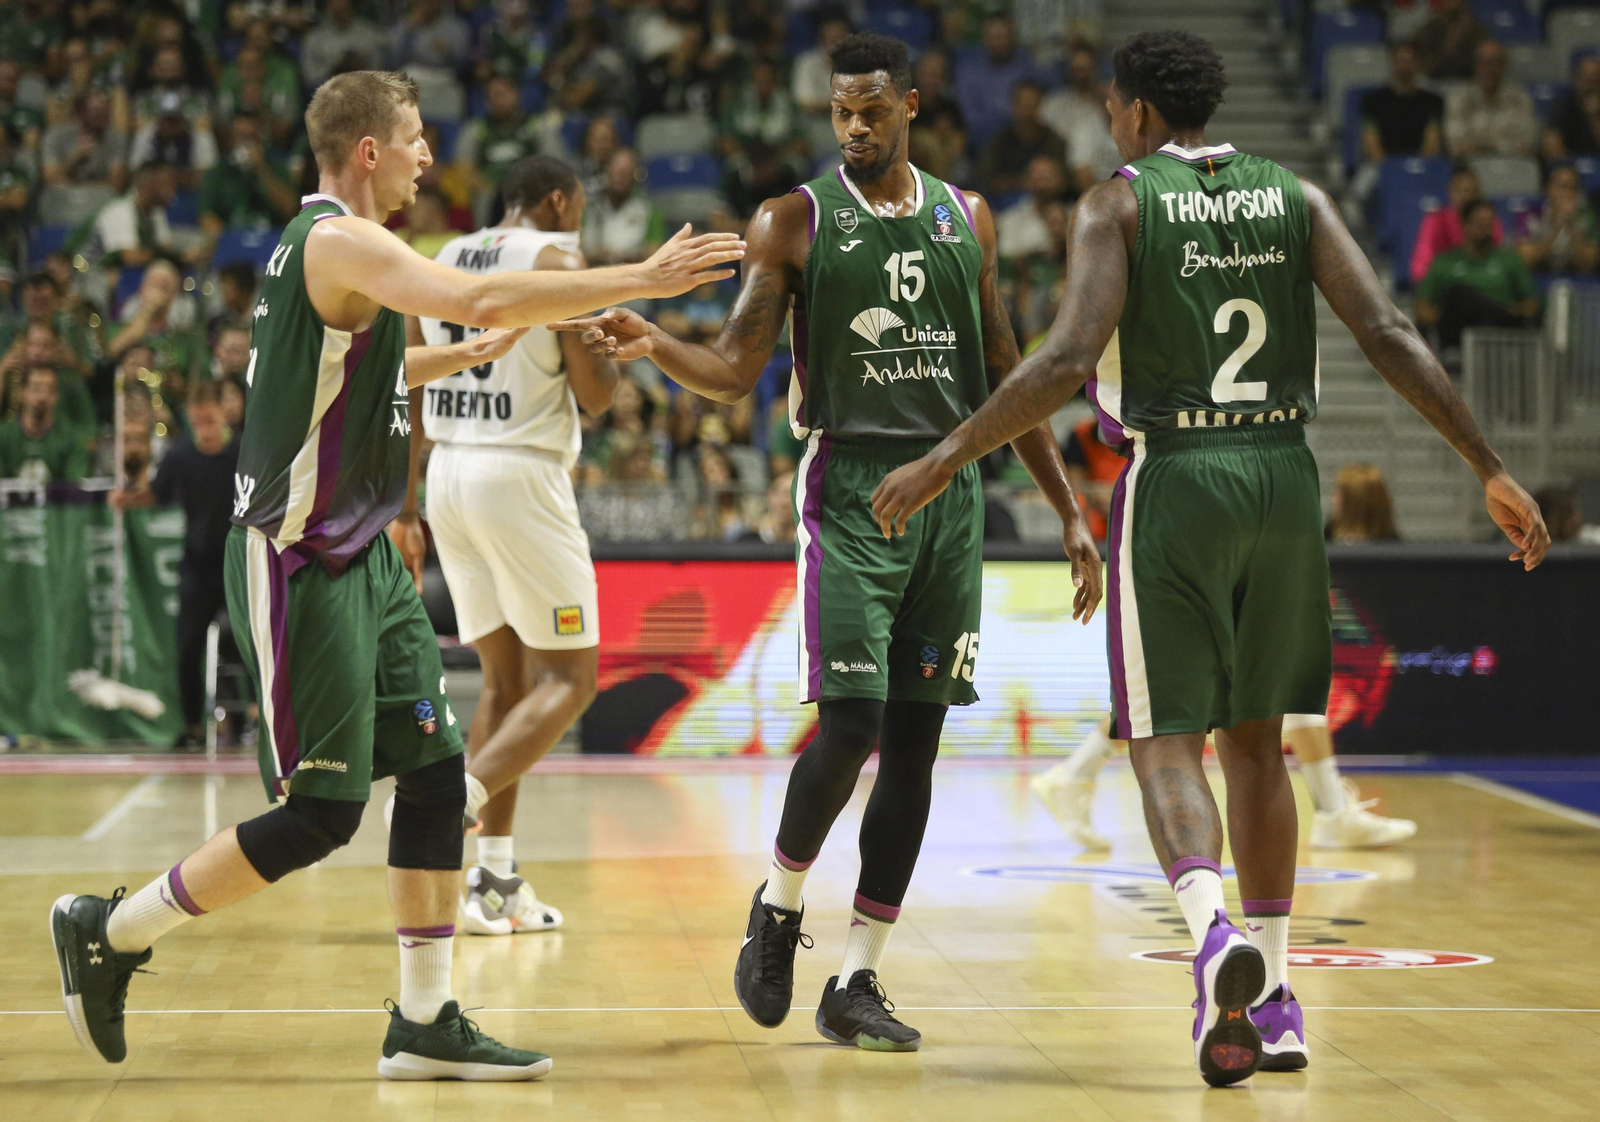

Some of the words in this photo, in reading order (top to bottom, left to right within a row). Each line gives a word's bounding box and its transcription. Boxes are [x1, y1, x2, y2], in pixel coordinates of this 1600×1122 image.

[1160, 187, 1285, 225] THOMPSON
[883, 250, 926, 302] 15
[902, 324, 957, 346] Unicaja
[1211, 298, 1267, 403] 2
[427, 388, 512, 420] TRENTO
[950, 631, 979, 683] 15
